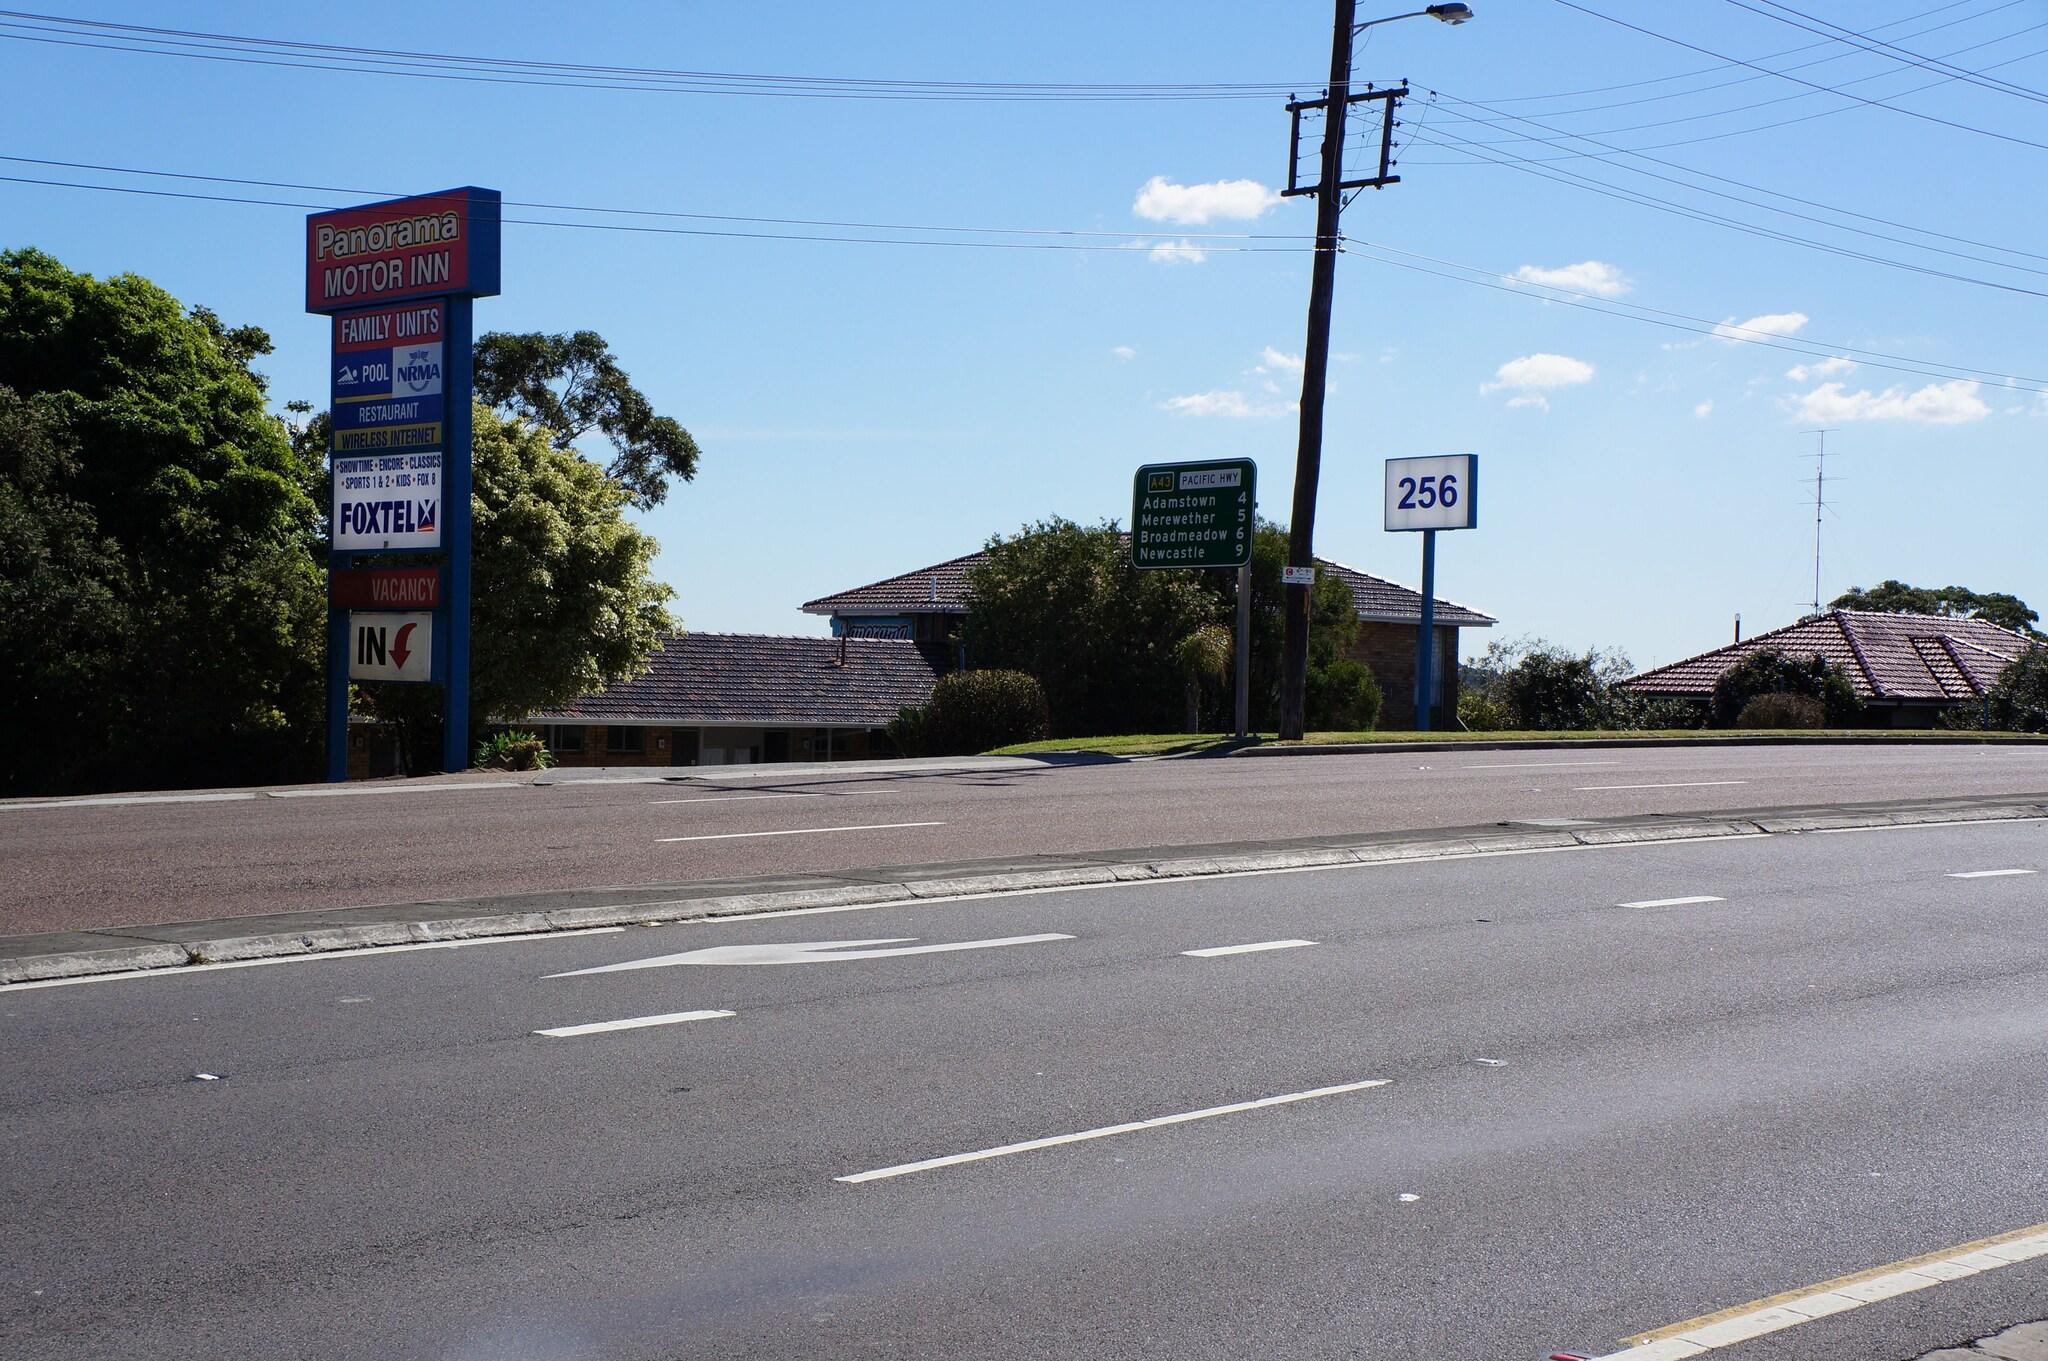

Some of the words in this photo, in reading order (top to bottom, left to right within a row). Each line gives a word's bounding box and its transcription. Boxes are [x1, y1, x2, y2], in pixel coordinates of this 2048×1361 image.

[317, 211, 459, 261] Panorama
[324, 259, 403, 298] MOTOR
[411, 251, 450, 287] INN
[342, 314, 391, 343] FAMILY
[396, 308, 438, 337] UNITS
[362, 363, 389, 383] POOL
[397, 364, 440, 383] NRMA
[359, 402, 419, 422] RESTAURANT
[342, 431, 388, 449] WIRELESS
[390, 427, 436, 446] INTERNET
[340, 460, 374, 474] SHOWTIME
[379, 457, 404, 471] ENCORE
[409, 455, 441, 469] CLASSICS
[345, 476, 371, 489] SPORTS
[378, 476, 383, 488] &
[385, 475, 390, 488] 2
[396, 474, 411, 487] KIDS
[417, 473, 430, 486] FOX
[431, 473, 436, 485] 8
[1151, 477, 1170, 488] A43
[1182, 474, 1215, 486] PACIFIC
[1220, 472, 1238, 483] HWY
[1143, 496, 1216, 510] Adamstown
[1238, 491, 1247, 504] 4
[1397, 475, 1458, 510] 256
[340, 500, 415, 535] FOXTEL
[1142, 512, 1215, 526] Merewether
[1237, 509, 1246, 522] 5
[1141, 528, 1228, 543] Broadmeadow
[1236, 527, 1244, 539] 6
[1140, 546, 1205, 560] Newcastle
[1235, 544, 1243, 557] 9
[372, 577, 436, 601] VACANCY
[358, 626, 387, 666] IN
